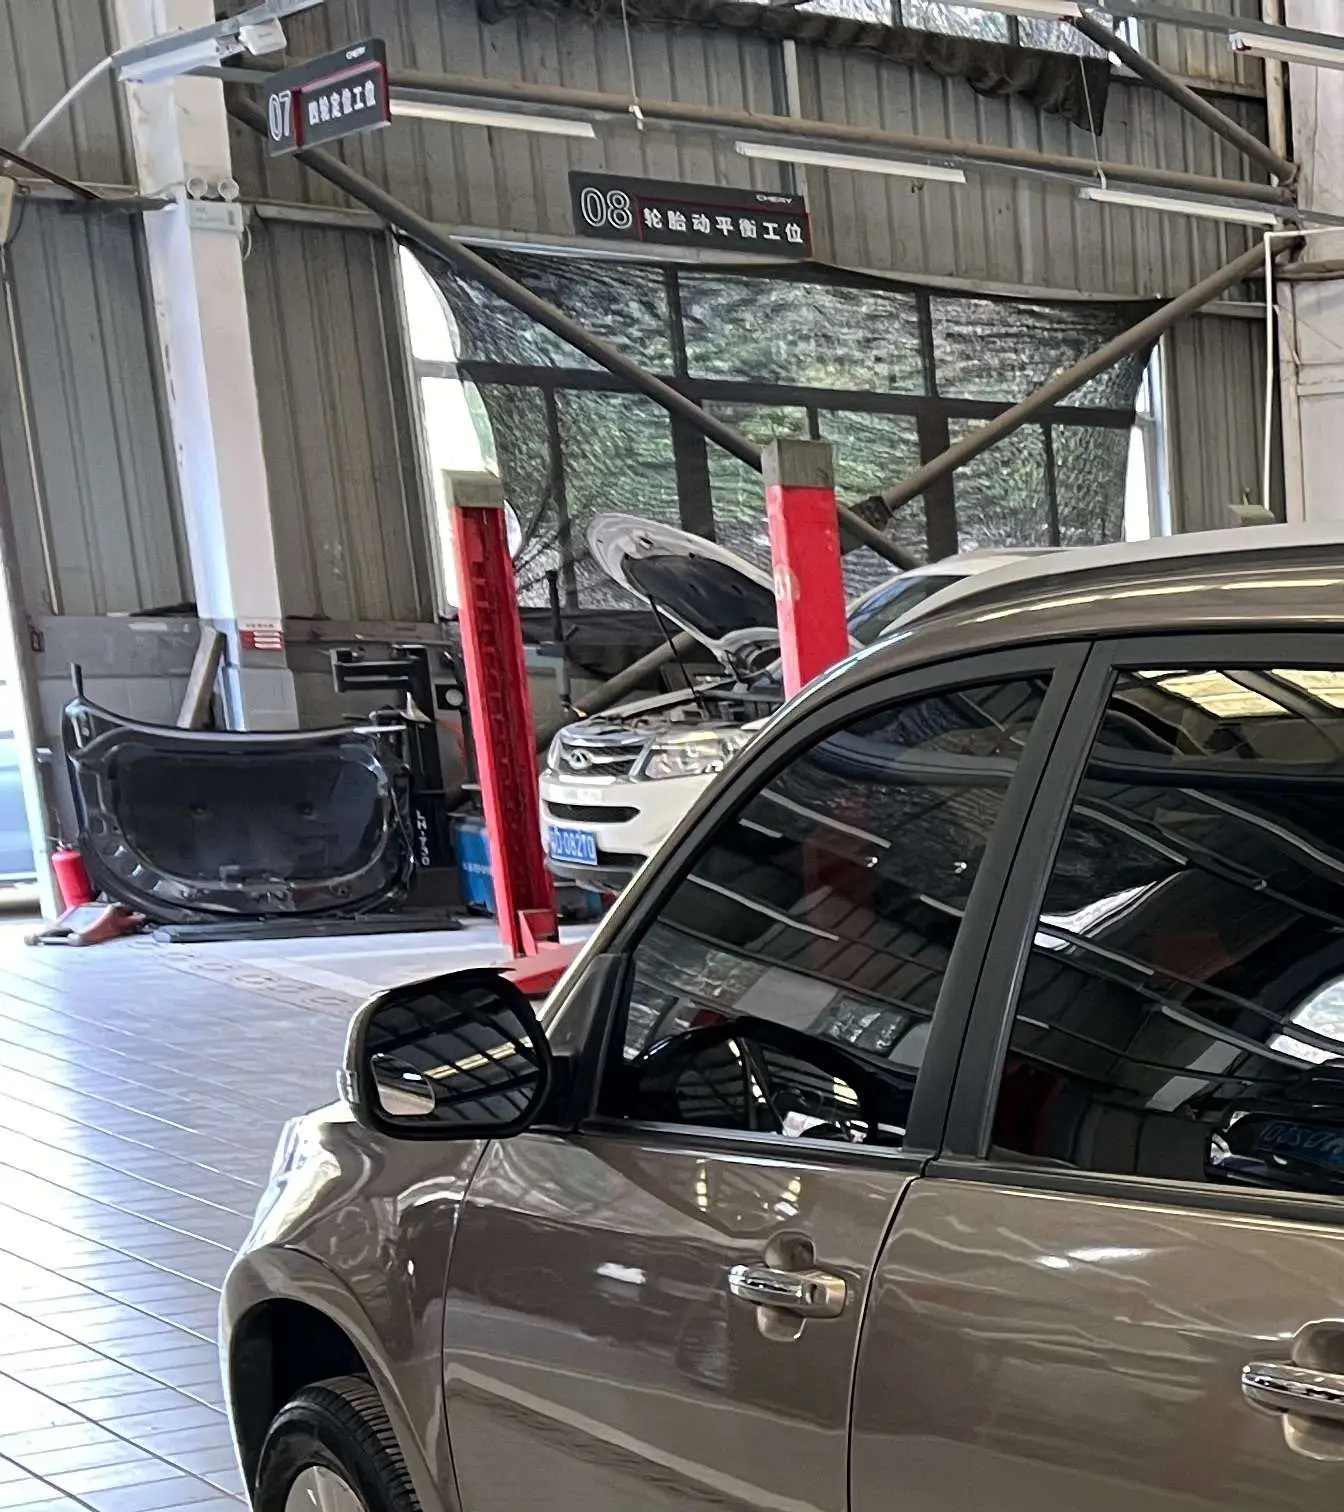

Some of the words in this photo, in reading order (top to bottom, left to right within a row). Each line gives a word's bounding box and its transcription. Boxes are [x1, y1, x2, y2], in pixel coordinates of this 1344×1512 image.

[268, 89, 291, 142] 07
[581, 186, 633, 230] 08
[643, 206, 803, 243] 轮胎动平衡工位
